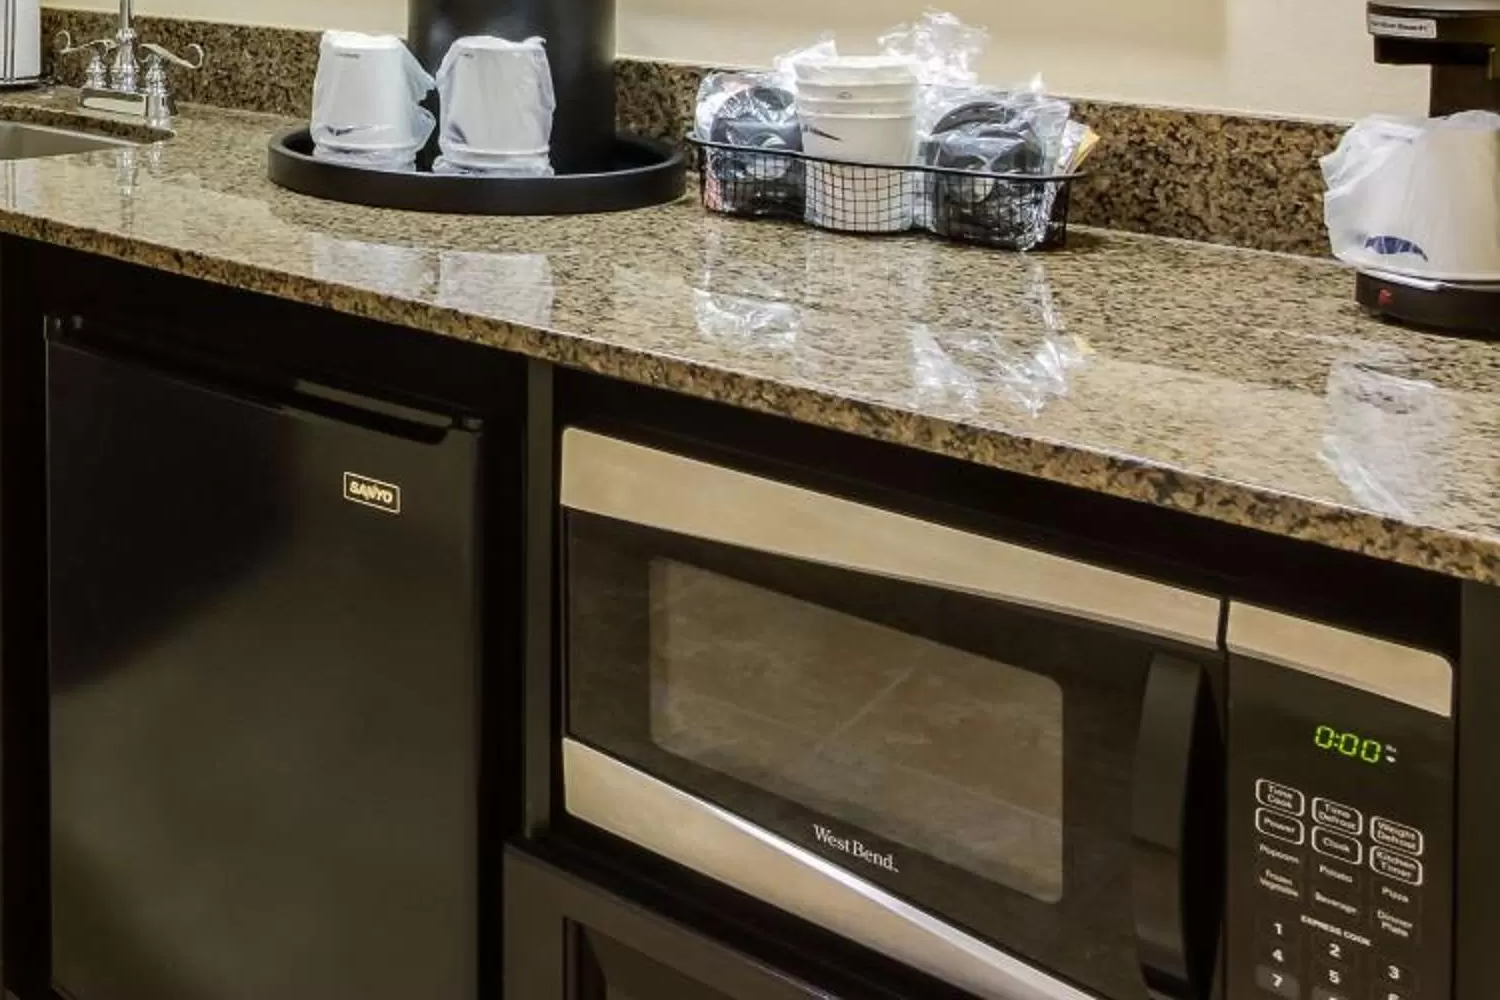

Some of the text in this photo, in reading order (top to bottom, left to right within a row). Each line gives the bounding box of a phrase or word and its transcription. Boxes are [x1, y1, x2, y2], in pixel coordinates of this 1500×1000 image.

[350, 481, 393, 504] SANYO
[1314, 725, 1381, 763] 0:00
[813, 823, 895, 872] West Bend
[1273, 922, 1283, 936] 1
[1272, 949, 1284, 962] 4
[1329, 943, 1341, 959] 2
[1272, 972, 1284, 988] 7
[1329, 969, 1341, 985] 5
[1388, 964, 1400, 980] 3
